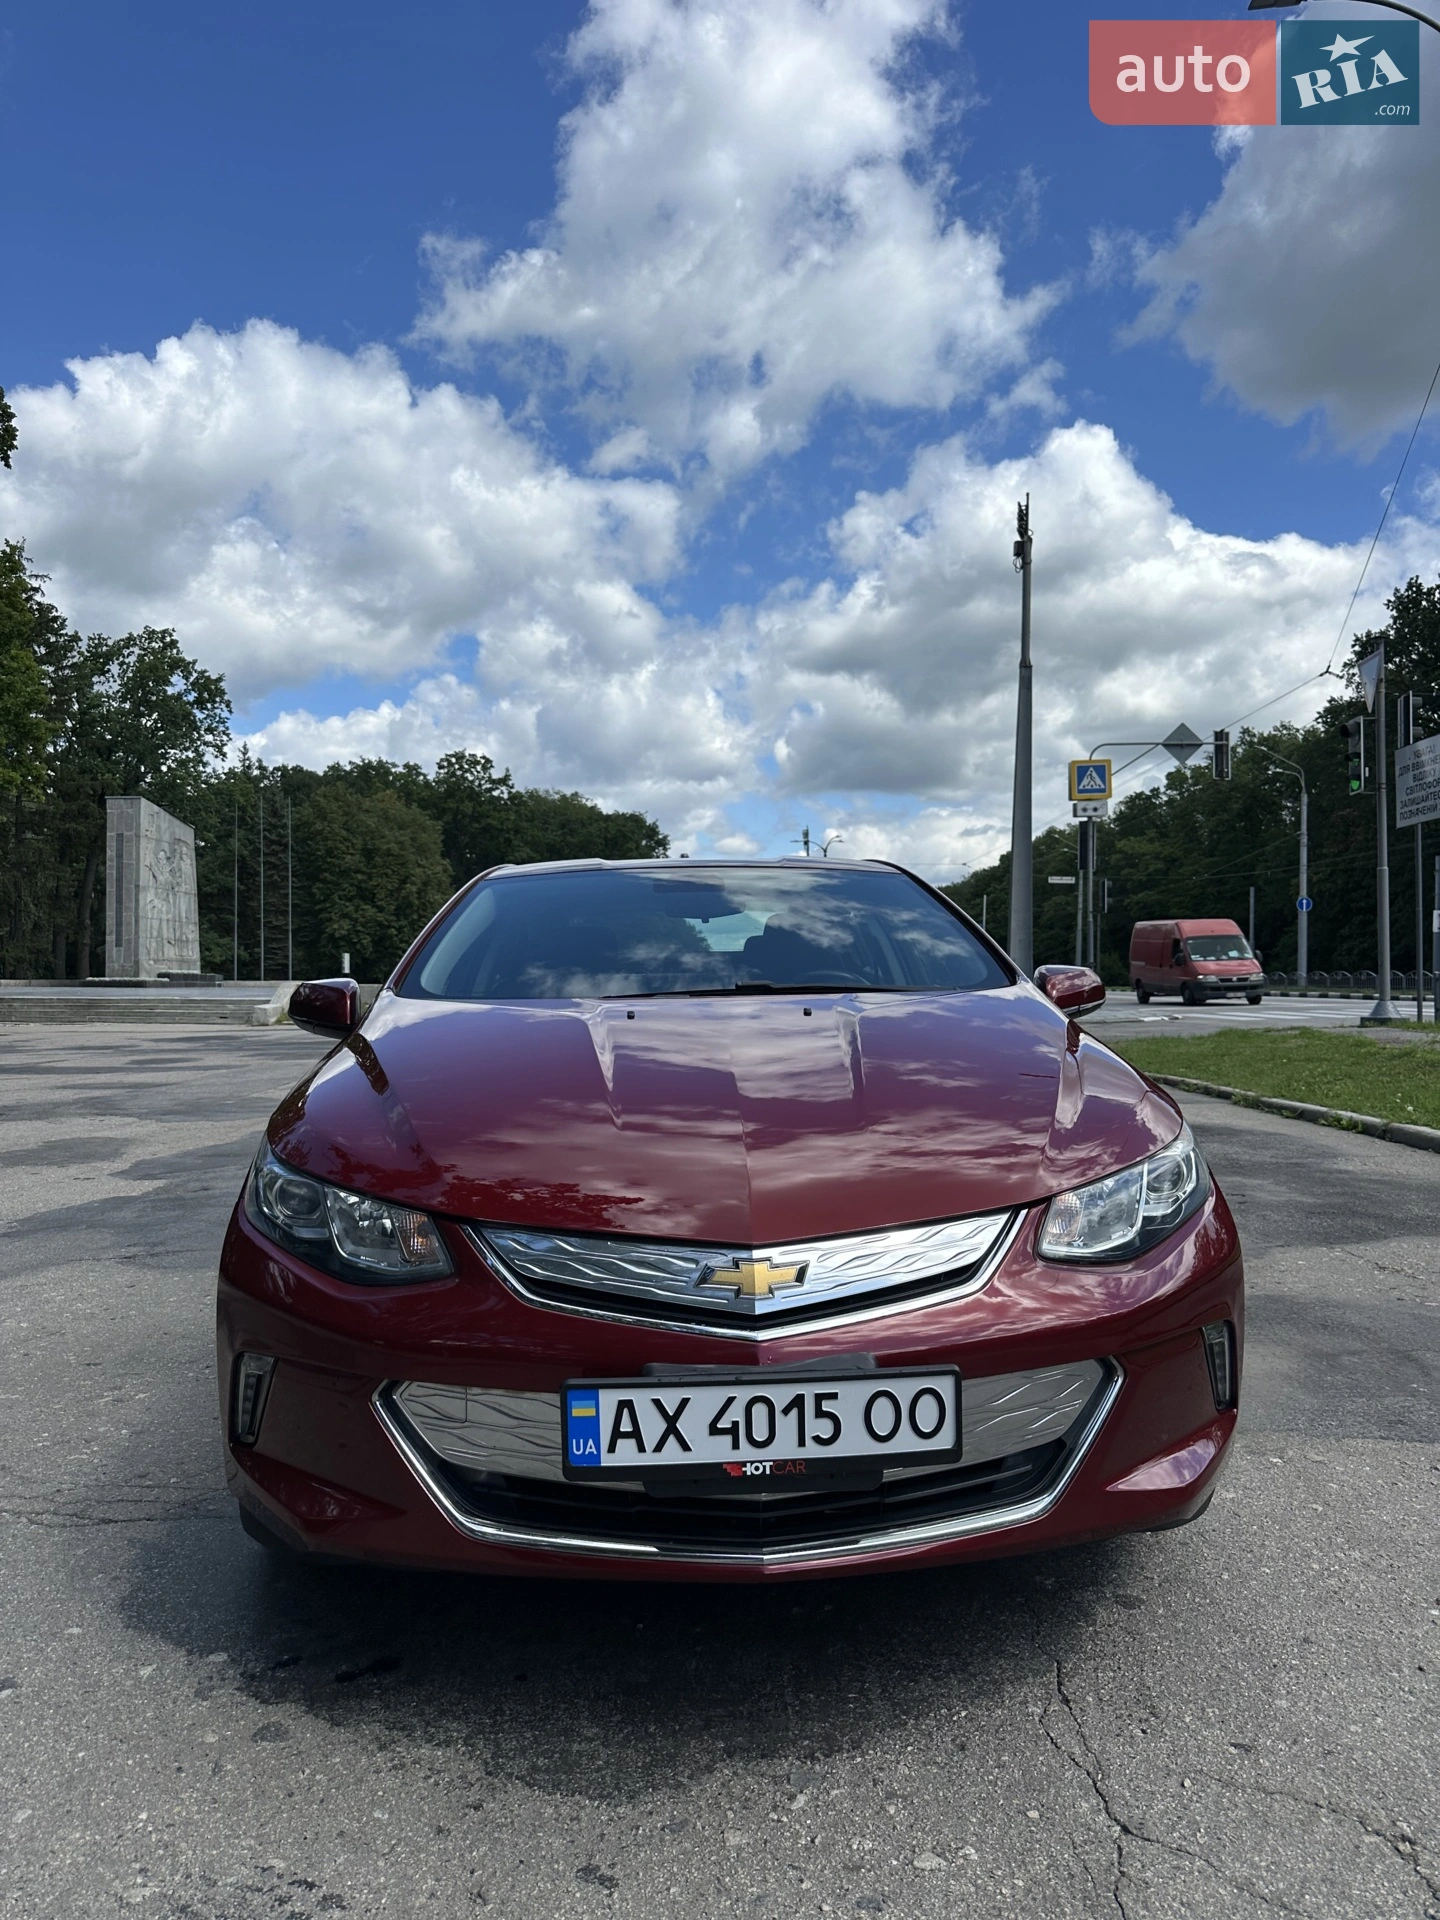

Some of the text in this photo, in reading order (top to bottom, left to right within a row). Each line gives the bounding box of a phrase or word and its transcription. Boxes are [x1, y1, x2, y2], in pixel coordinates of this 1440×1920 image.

[1411, 755, 1440, 772] ВВІМКНЕ
[606, 1396, 692, 1454] AX
[708, 1391, 842, 1450] 4015
[572, 1438, 597, 1455] UA
